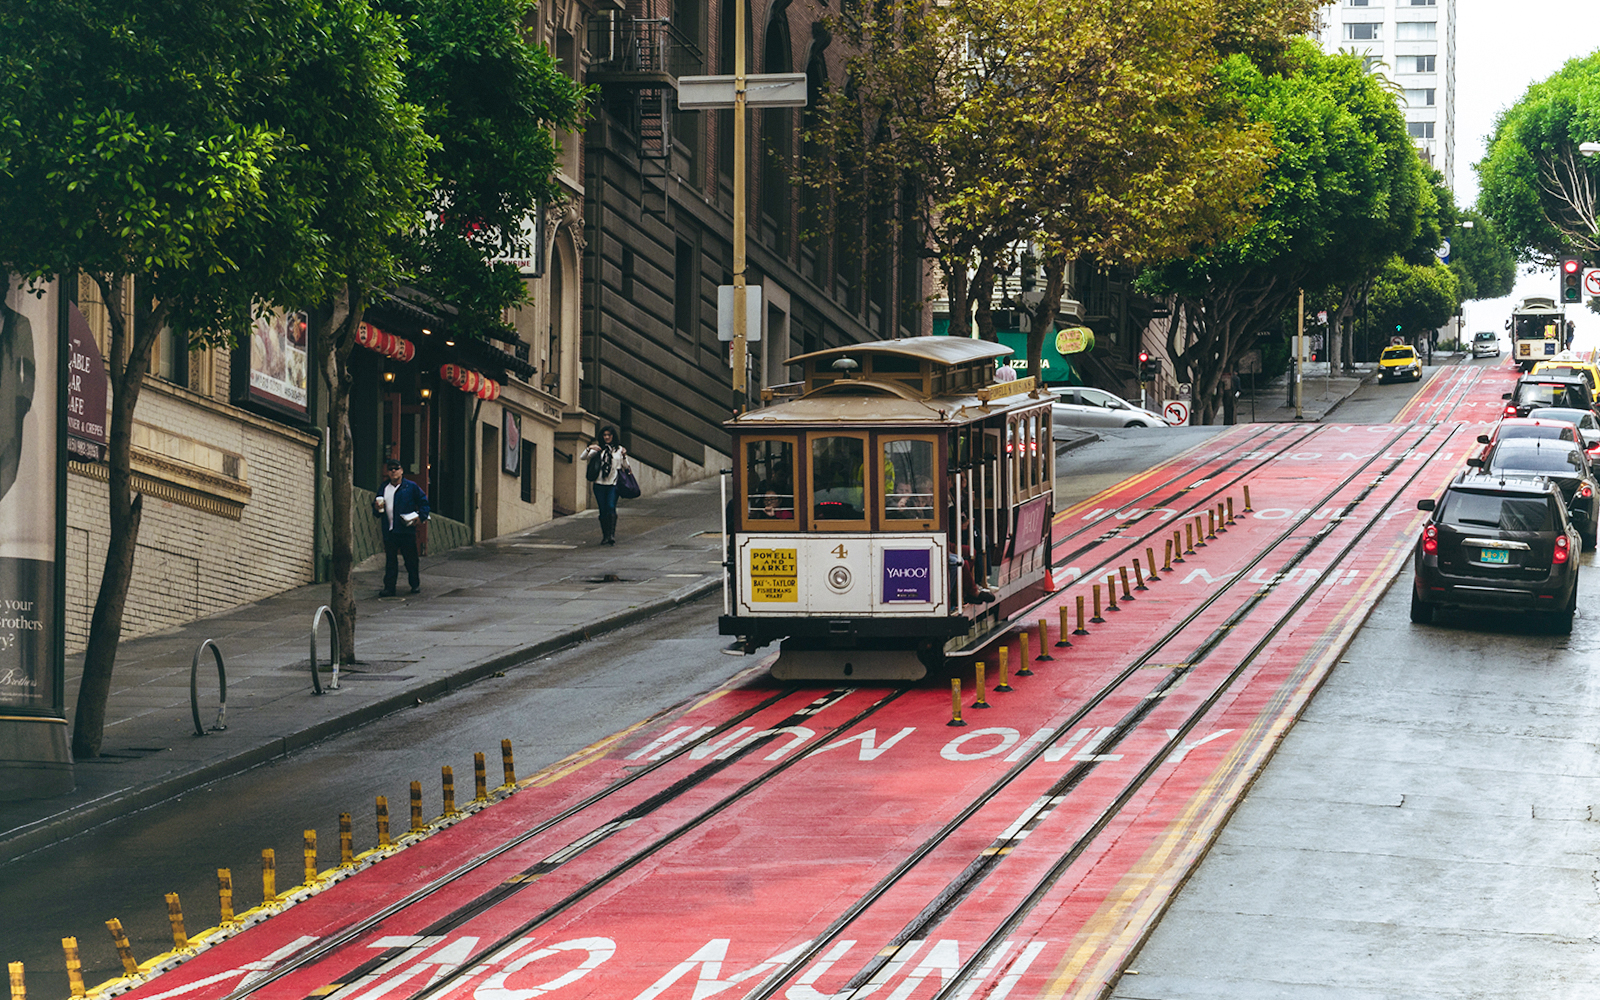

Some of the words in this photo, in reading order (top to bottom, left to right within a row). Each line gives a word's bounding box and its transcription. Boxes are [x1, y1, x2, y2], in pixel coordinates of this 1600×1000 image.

[86, 422, 104, 437] CREPES
[1252, 508, 1413, 521] ONLY
[753, 552, 794, 560] POWELL
[830, 543, 849, 559] 4
[886, 567, 928, 578] YAHOO!
[1180, 568, 1360, 586] MUNI
[753, 579, 765, 587] BAY
[772, 579, 796, 587] TAYLOR
[5, 600, 34, 614] your
[623, 725, 917, 761] MUNI
[940, 726, 1236, 763] ONLY
[630, 939, 1048, 1000] MUNI
